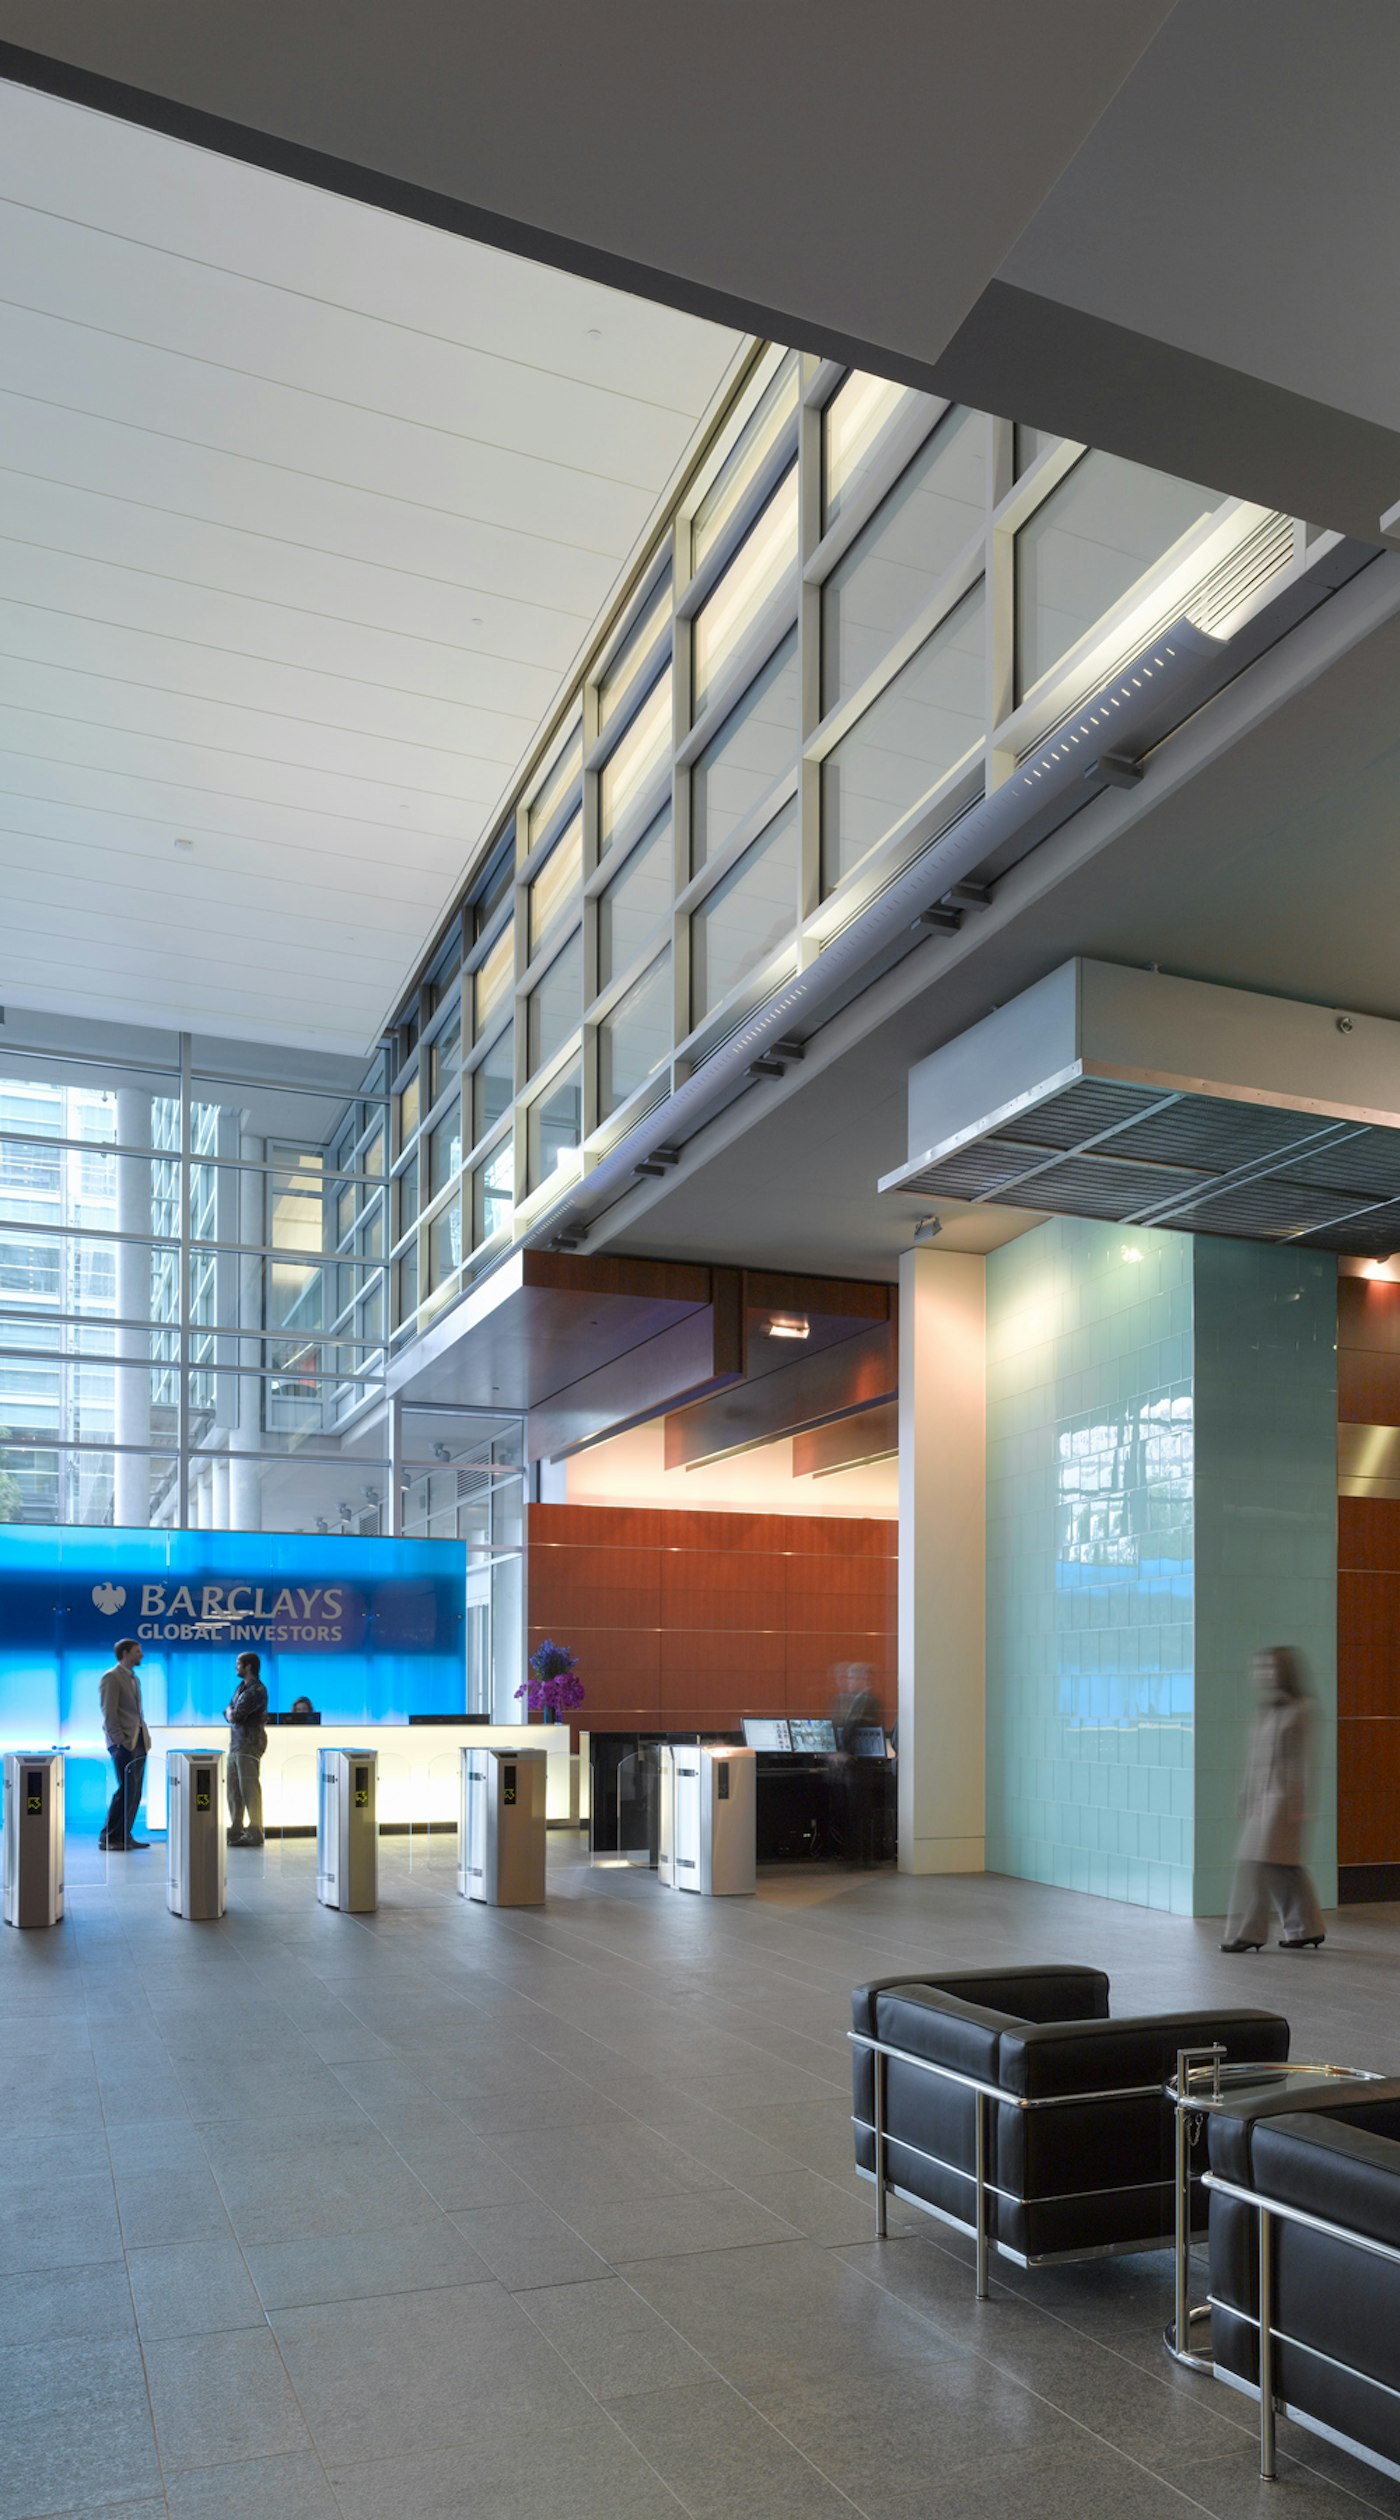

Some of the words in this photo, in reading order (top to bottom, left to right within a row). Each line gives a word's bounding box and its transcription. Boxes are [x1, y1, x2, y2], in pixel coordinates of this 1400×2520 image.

[140, 1585, 342, 1619] BARCLAYS
[137, 1623, 221, 1641] GLOBAL
[230, 1624, 342, 1642] INVESTORS
